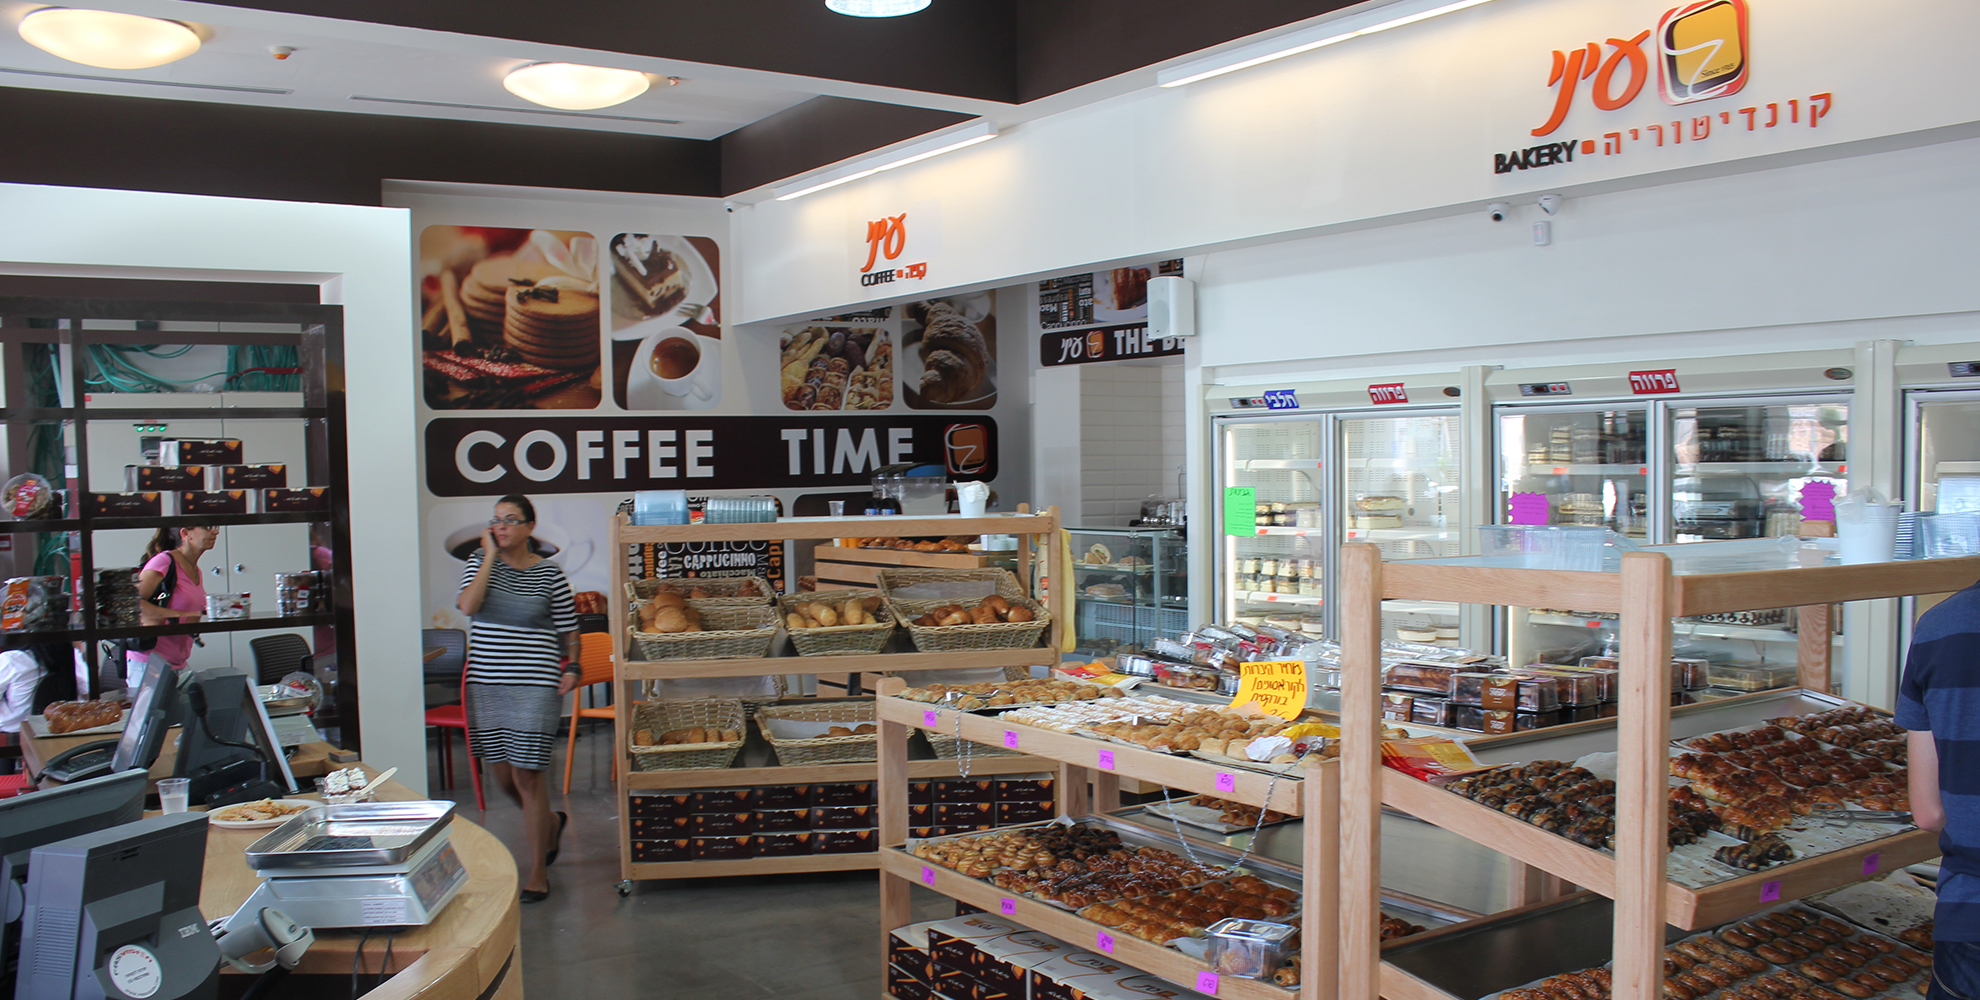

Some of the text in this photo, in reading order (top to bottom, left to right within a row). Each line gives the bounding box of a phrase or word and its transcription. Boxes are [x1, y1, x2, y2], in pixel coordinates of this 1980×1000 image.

[1603, 92, 1832, 156] קונדיטוריה
[1494, 139, 1577, 174] BAKERY
[861, 269, 896, 286] COFFEE
[905, 262, 927, 280] קפה
[1114, 327, 1153, 355] THE
[1630, 372, 1677, 391] פרווה
[1265, 391, 1298, 408] חלבי
[1369, 386, 1405, 402] פרווה
[455, 427, 914, 483] COFFEE TIME
[683, 552, 756, 570] CAPPUCINNO
[178, 922, 200, 938] IBM
